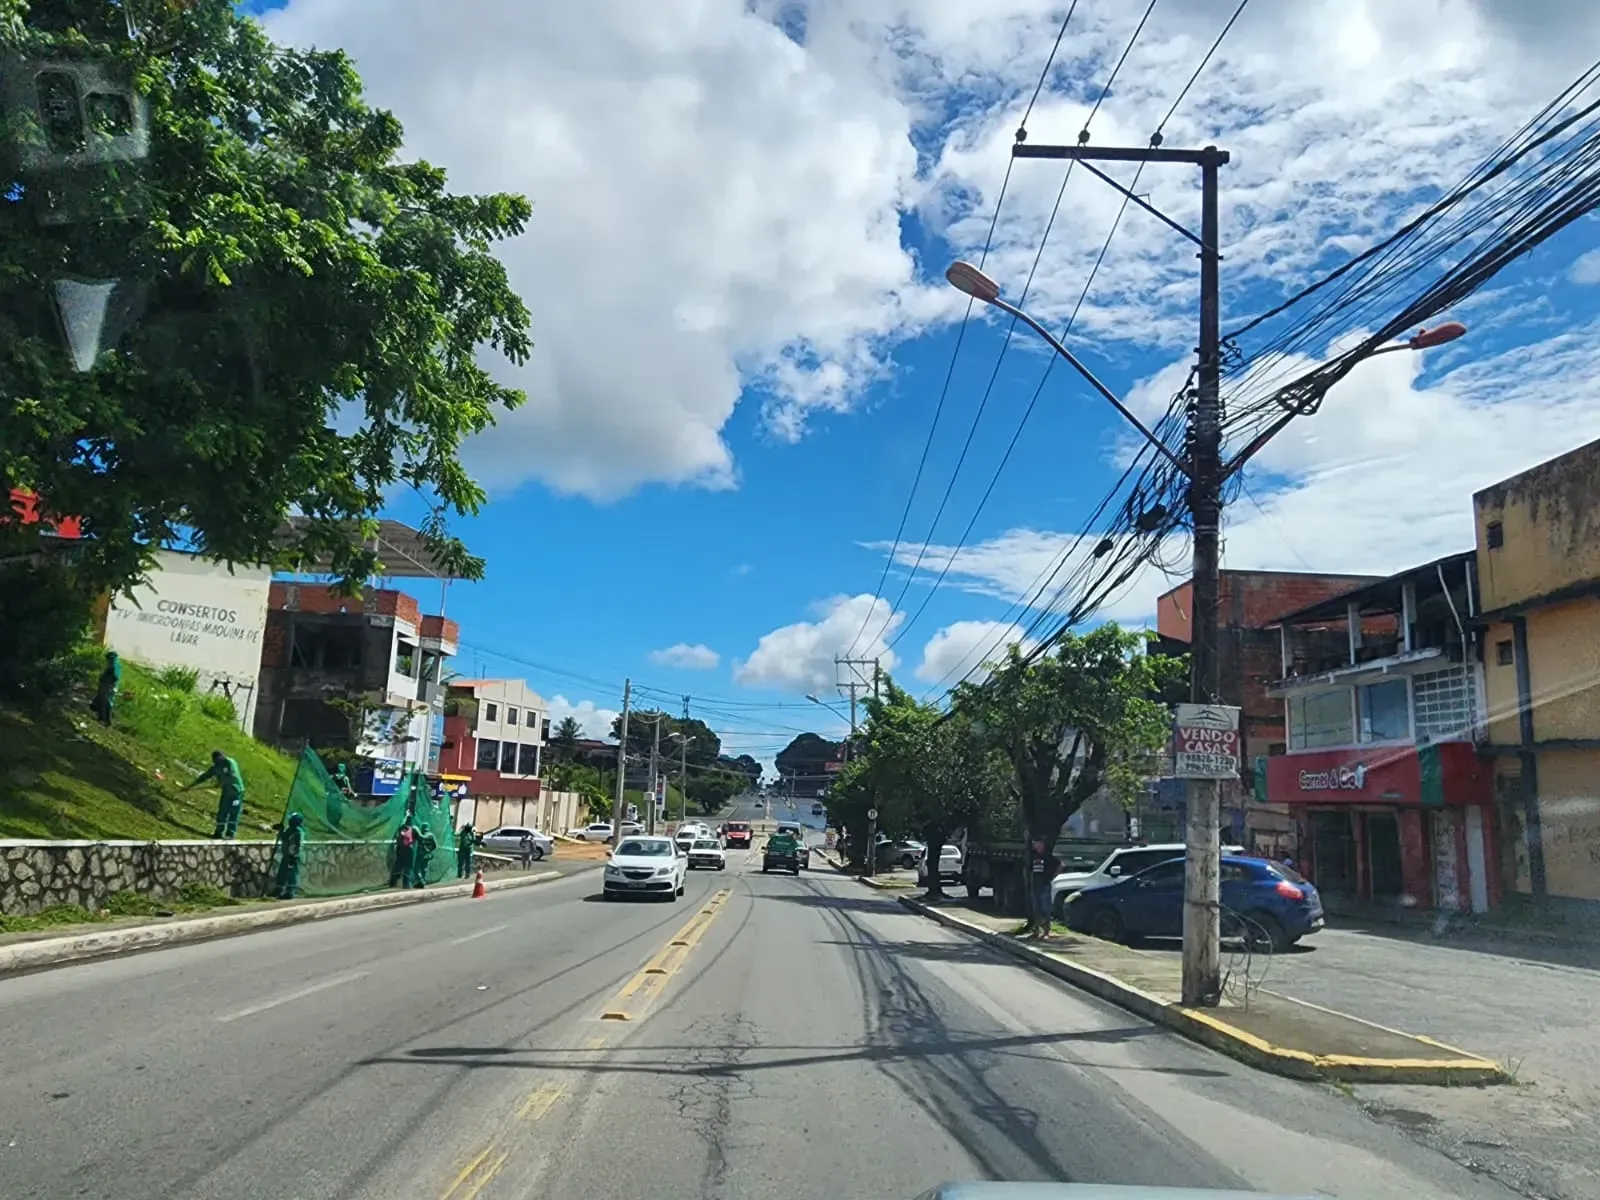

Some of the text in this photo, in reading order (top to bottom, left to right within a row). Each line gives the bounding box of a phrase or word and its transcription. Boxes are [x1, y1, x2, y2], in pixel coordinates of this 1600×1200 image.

[157, 600, 237, 623] CONSERTOS
[117, 608, 132, 619] TV
[246, 631, 260, 644] DE
[169, 631, 199, 646] LAVAR
[1179, 728, 1236, 743] VENDO
[1185, 741, 1231, 755] CASAS
[1329, 769, 1338, 789] &
